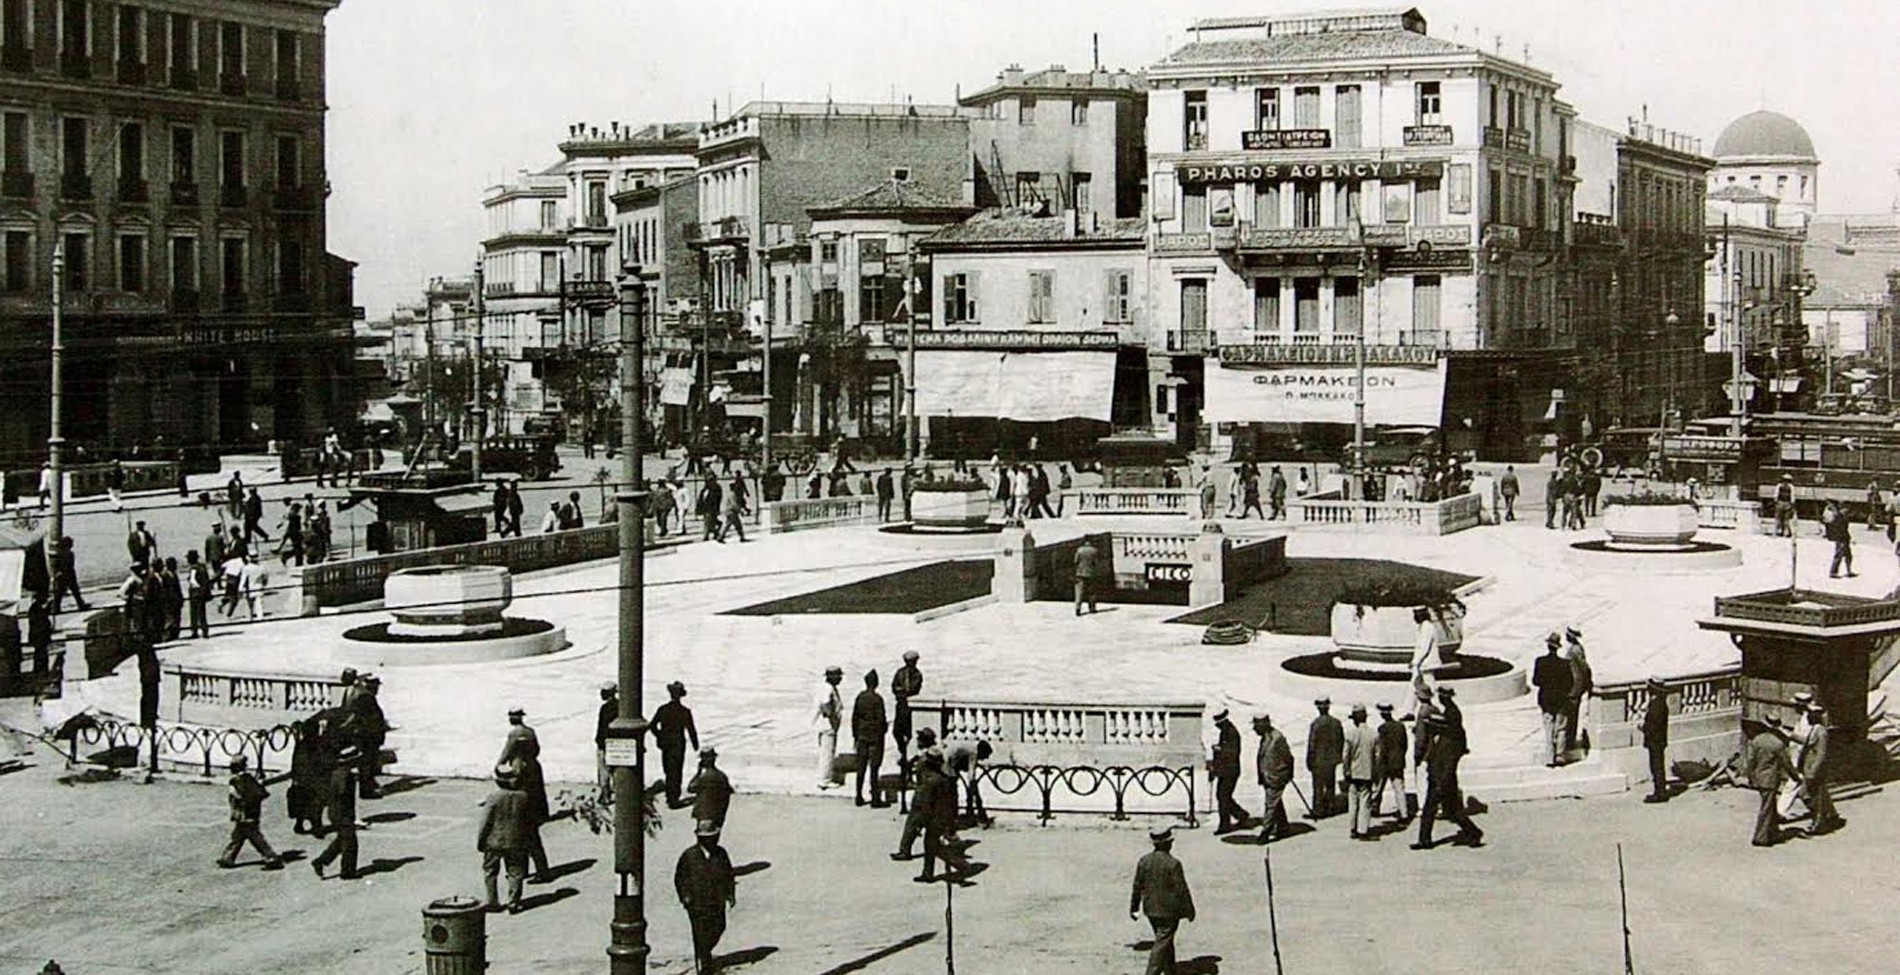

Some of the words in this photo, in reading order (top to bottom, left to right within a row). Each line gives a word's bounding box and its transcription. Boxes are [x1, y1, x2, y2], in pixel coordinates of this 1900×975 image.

[1187, 164, 1278, 180] PHAROS
[1290, 163, 1380, 178] AGENCY
[184, 330, 226, 343] WHITE
[1252, 375, 1396, 387] ΦΑΡΜΑΚΕΟΝ
[1300, 391, 1360, 400] ΜΠΑΚΑΚΟ
